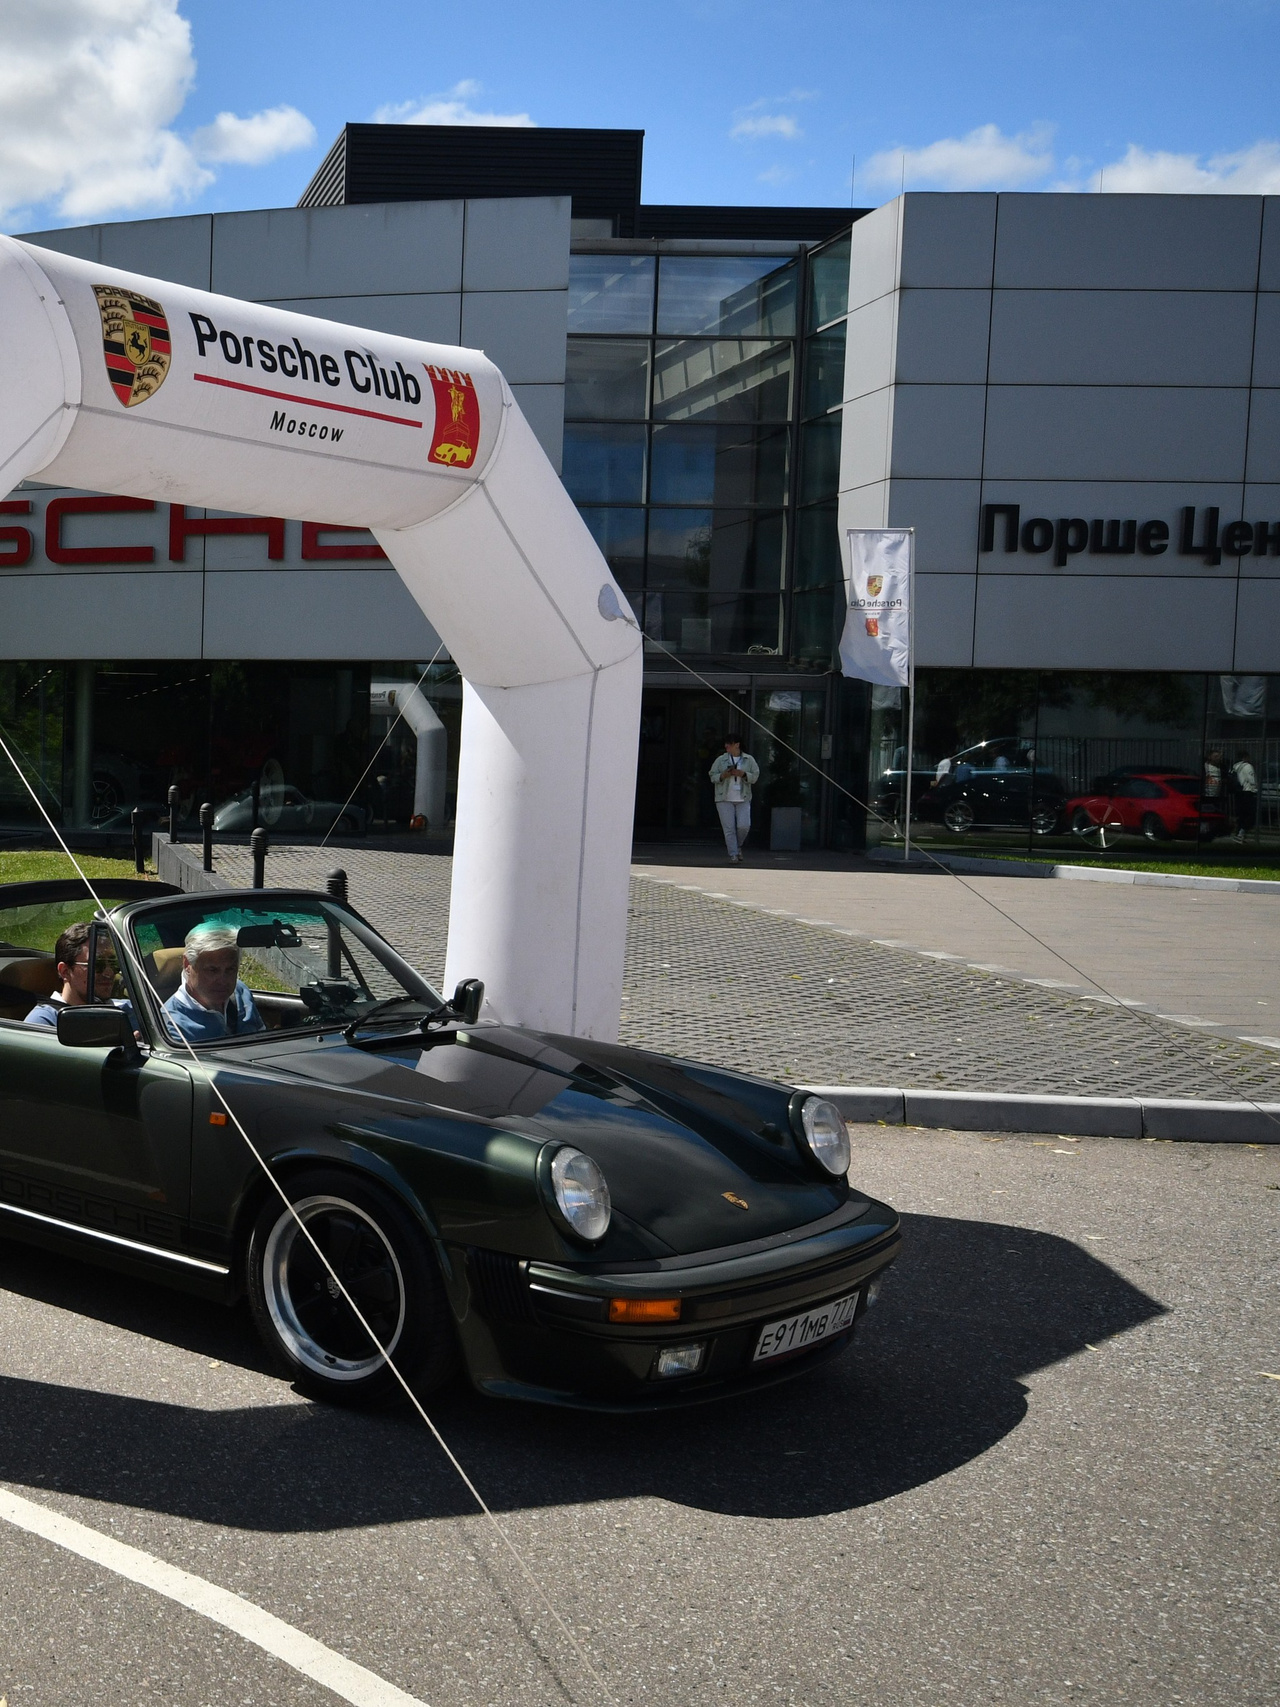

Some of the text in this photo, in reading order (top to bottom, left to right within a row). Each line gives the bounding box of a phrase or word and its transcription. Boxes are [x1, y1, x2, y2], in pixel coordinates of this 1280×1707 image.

[94, 286, 162, 313] PORSCHE
[188, 312, 422, 405] Porsche Club
[270, 410, 345, 442] Moscow
[981, 504, 1169, 566] Порше
